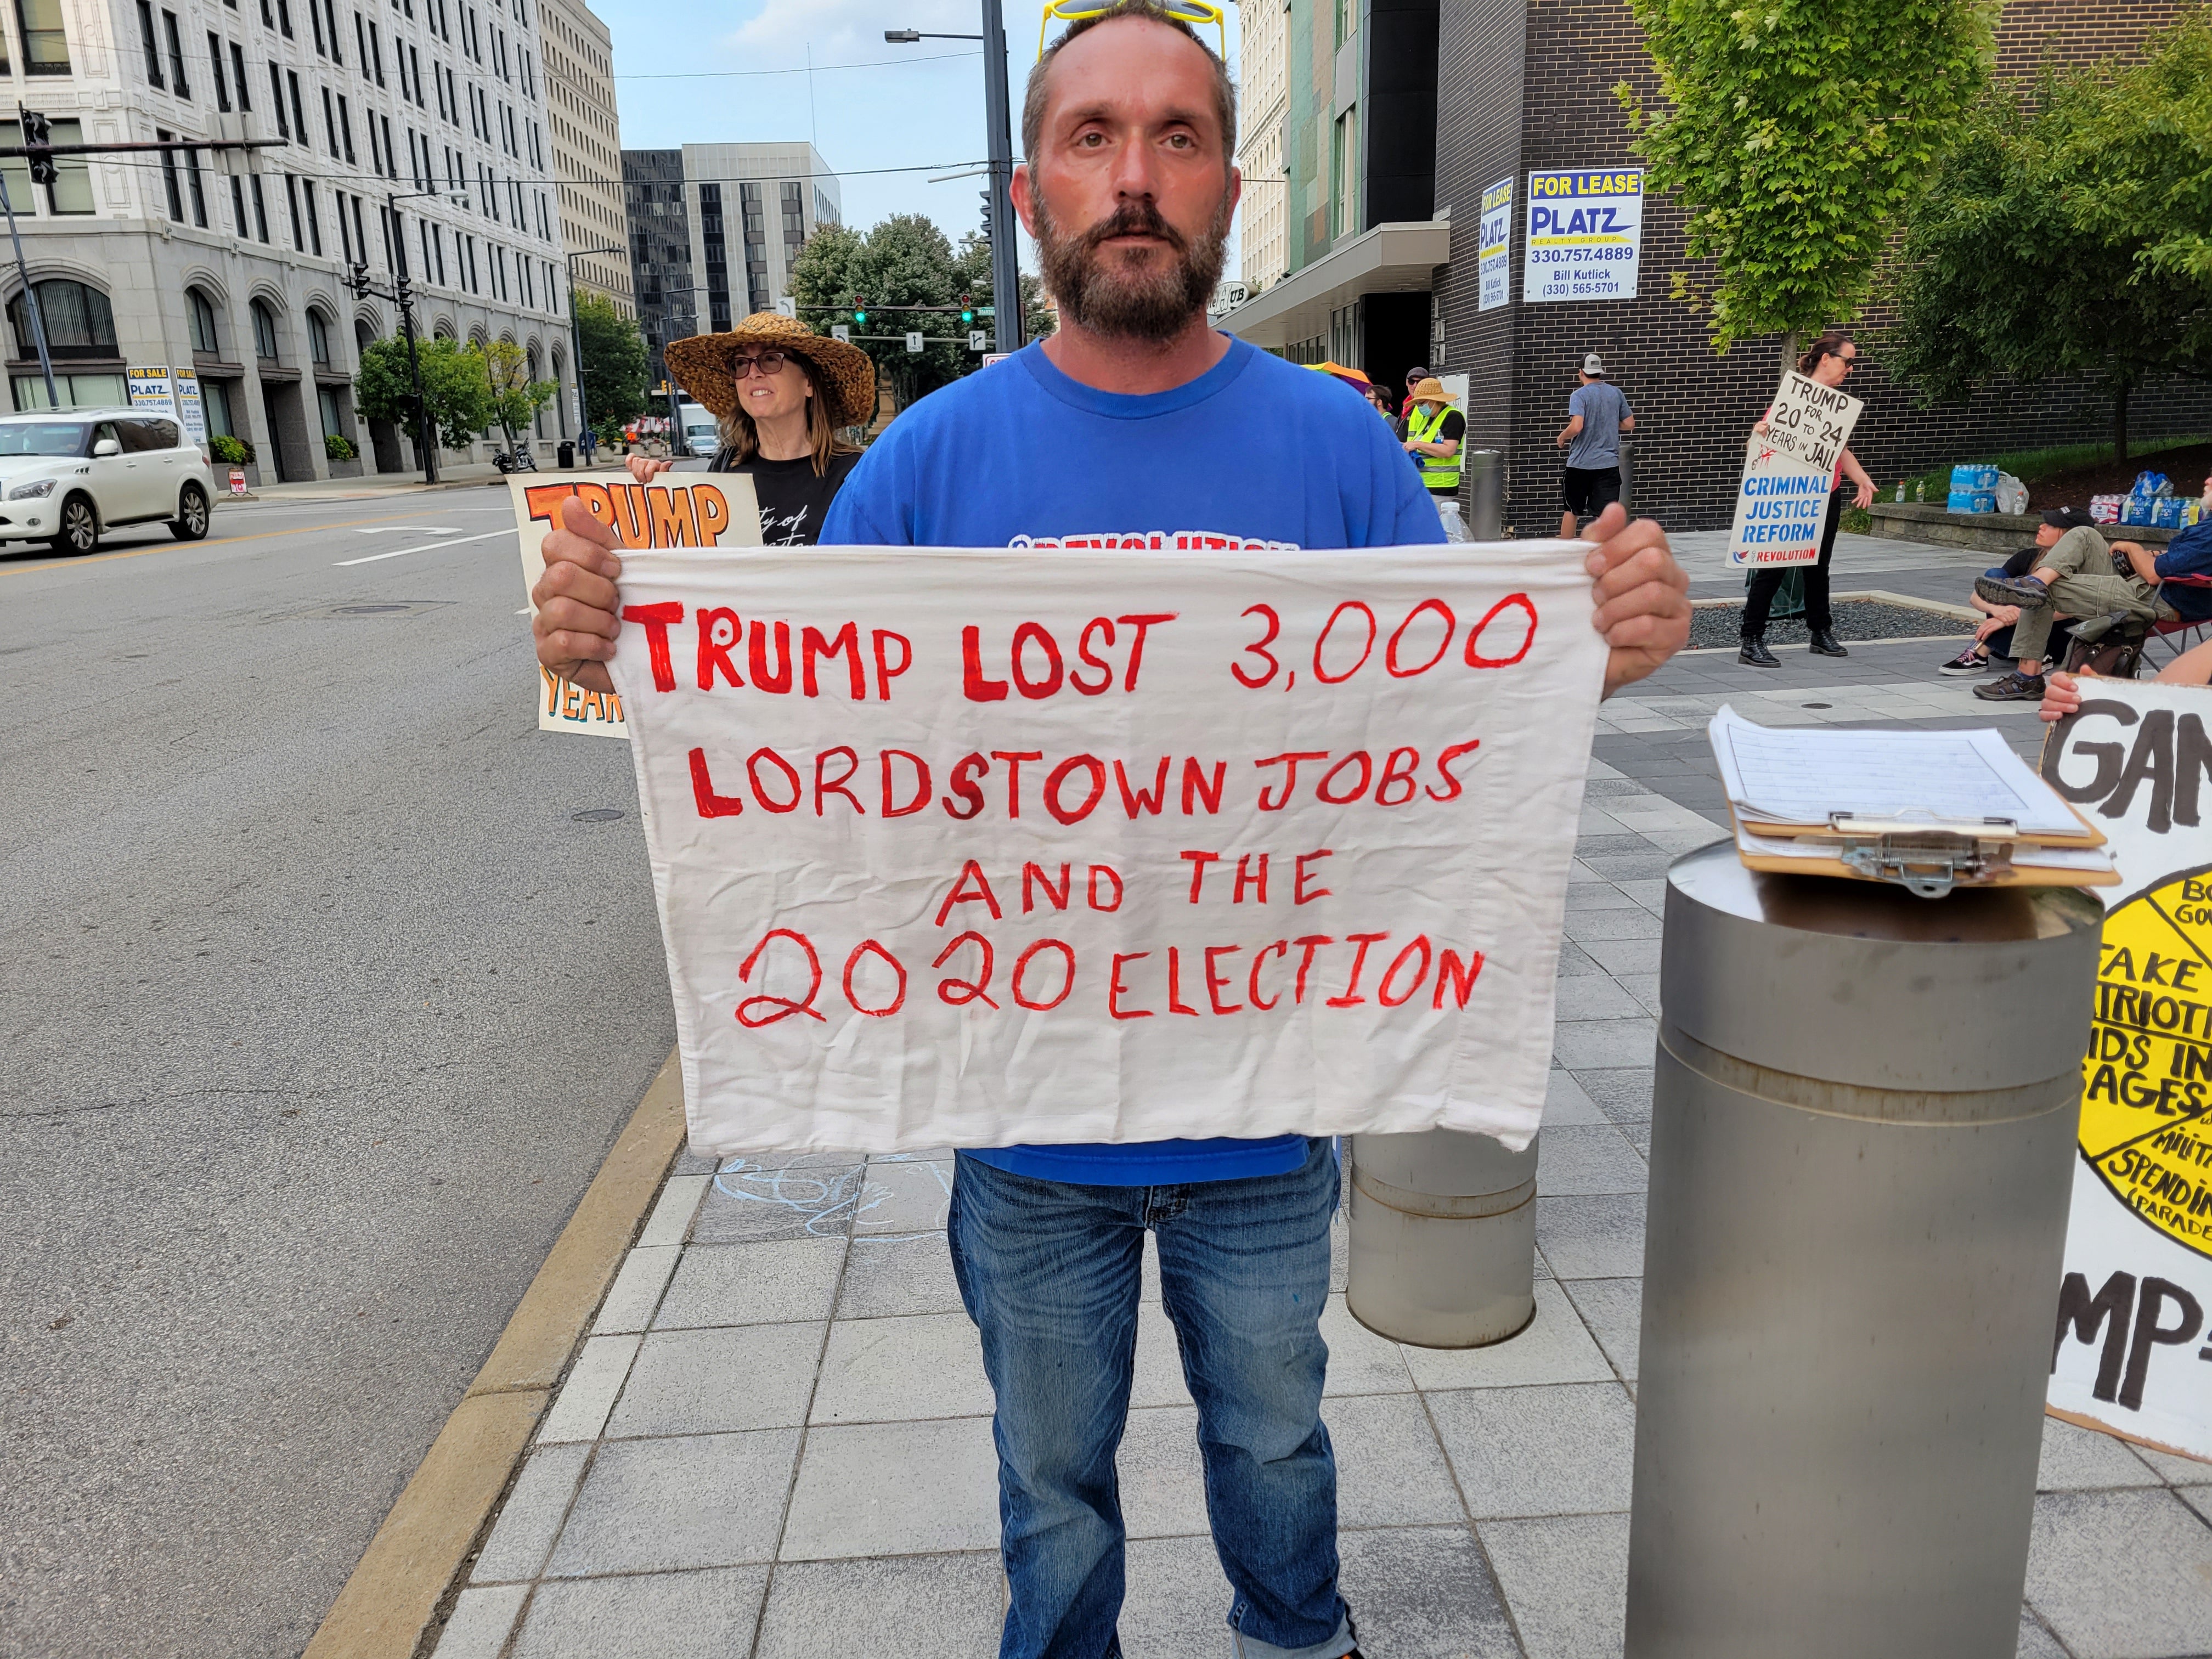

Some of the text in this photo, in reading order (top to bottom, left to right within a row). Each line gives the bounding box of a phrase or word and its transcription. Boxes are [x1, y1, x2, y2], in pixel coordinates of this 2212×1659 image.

[1533, 174, 1639, 196] FOR LEASE
[1483, 183, 1511, 213] FOR LEASE
[1531, 206, 1637, 236] PLATZ
[1481, 217, 1508, 250] PLATZ
[1480, 255, 1507, 275] 330.757.4889
[1531, 246, 1634, 263] 330.757.4889
[1554, 268, 1611, 281] Bill Kutlick
[1543, 281, 1619, 298] (330) 565-5701
[129, 368, 167, 378] FOR SALE
[177, 369, 195, 378] FOR SALE
[130, 385, 171, 395] PLATZ
[178, 385, 198, 395] PLATZ
[1791, 376, 1848, 414] TRUMP
[1775, 402, 1843, 448] 20 TO 24
[1804, 405, 1822, 422] FOR
[1765, 425, 1835, 473] YEARS IN JAIL
[1743, 476, 1829, 496] CRIMINAL
[524, 482, 729, 549] TRUMP
[777, 505, 808, 532] of
[1745, 499, 1821, 520] JUSTICE
[1742, 523, 1816, 543] REFORM
[1756, 548, 1816, 562] REVOLUTION
[622, 592, 1538, 703] TRUMP LOST 3,000
[688, 738, 1480, 826] LORDSTOWN JOBS
[934, 849, 1333, 928] AND THE
[734, 928, 1486, 1029] 2020 ELECTION
[2102, 943, 2203, 993] AKE
[2082, 1063, 2207, 1116] AGES
